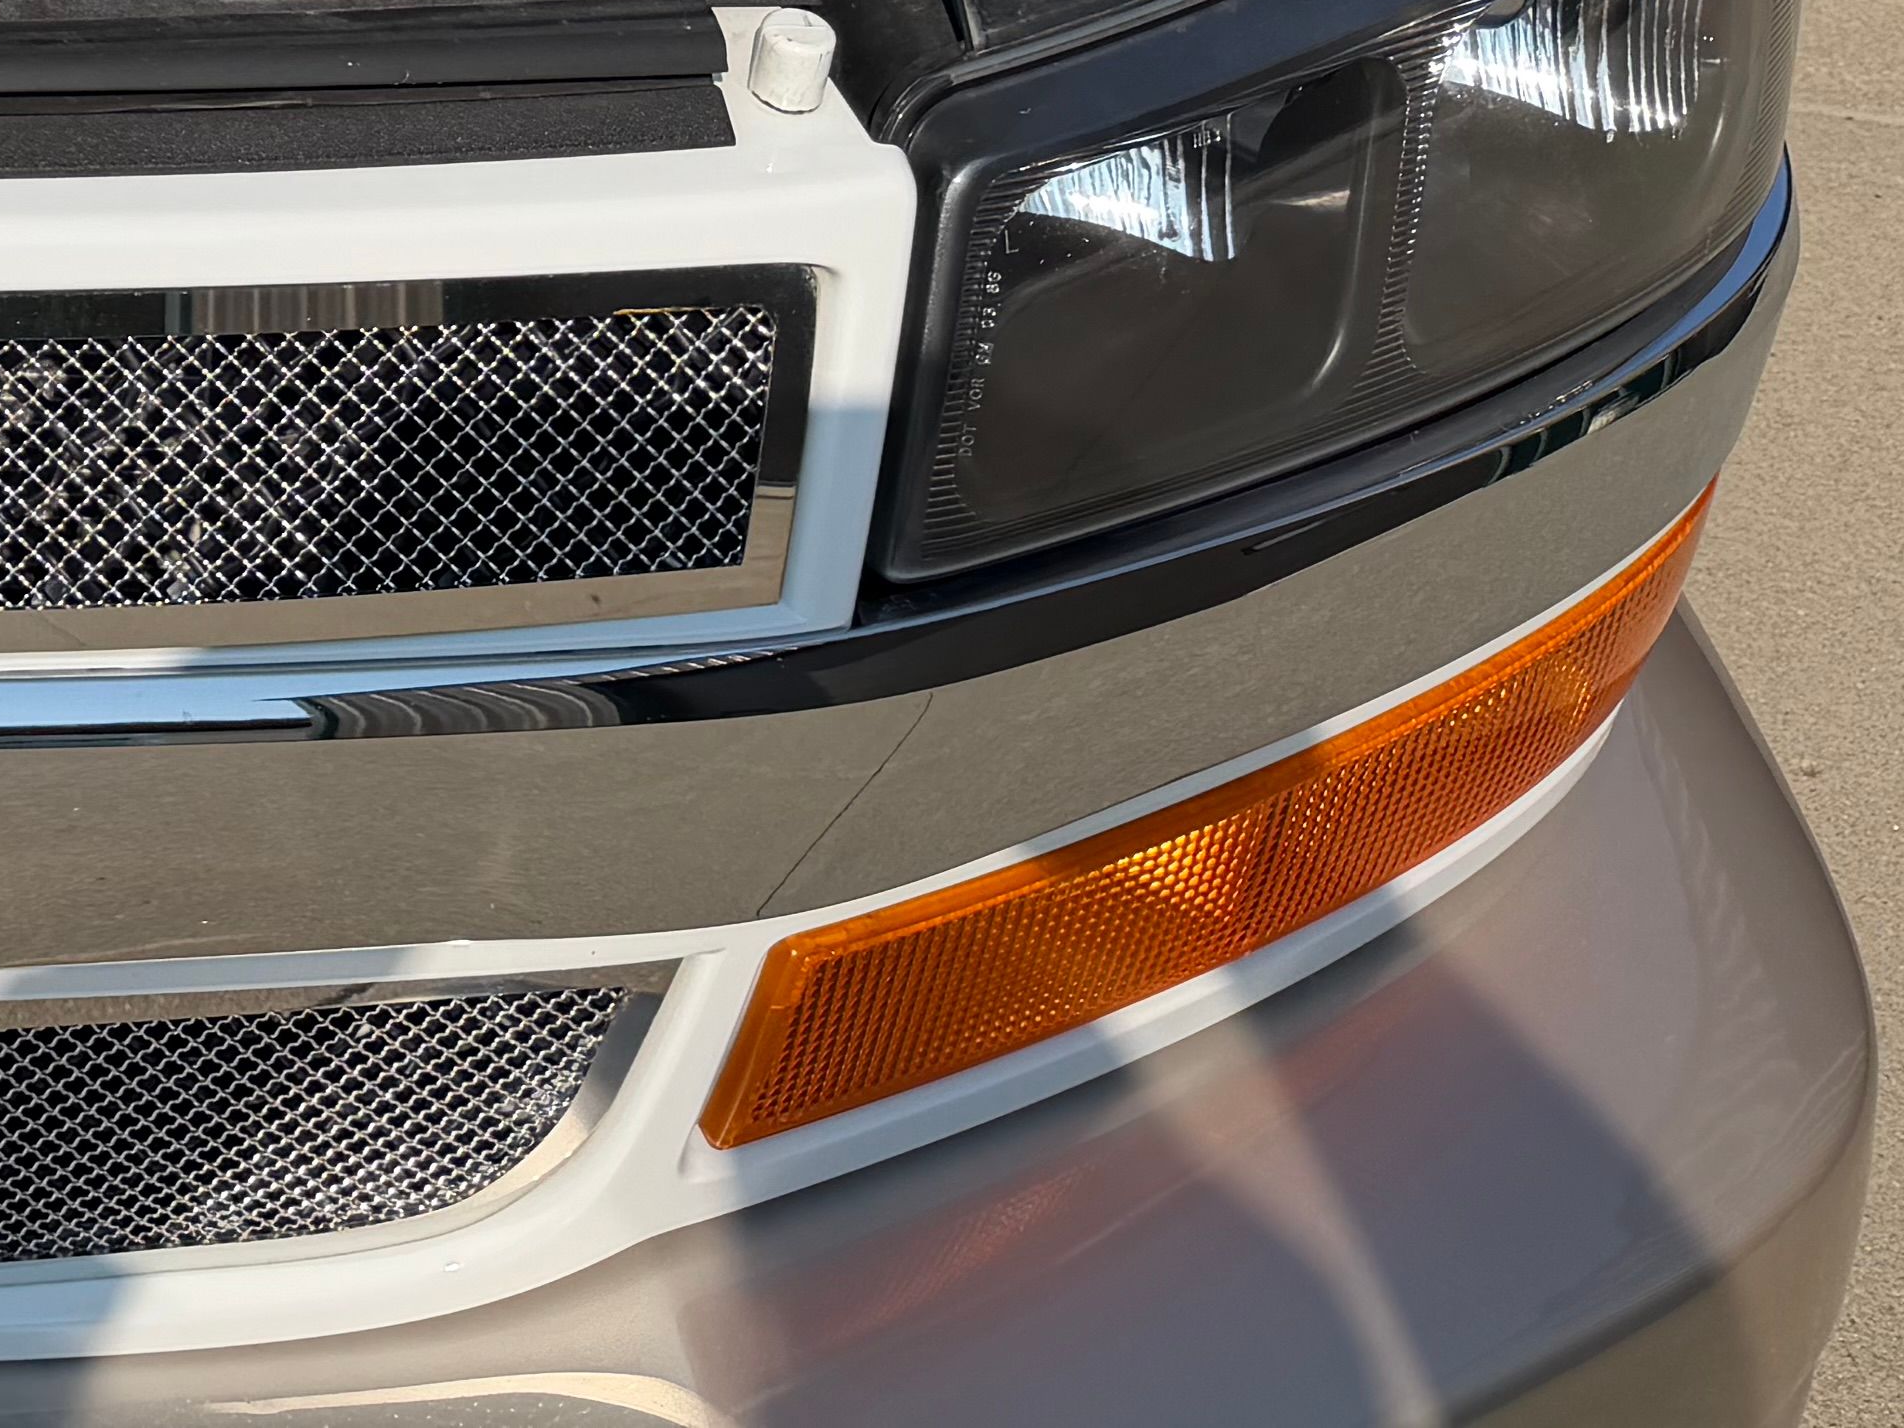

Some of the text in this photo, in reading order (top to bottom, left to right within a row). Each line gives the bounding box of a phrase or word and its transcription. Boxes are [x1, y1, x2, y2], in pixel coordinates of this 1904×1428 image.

[1005, 229, 1020, 255] L
[958, 423, 976, 456] DOT
[968, 378, 985, 410] VOR
